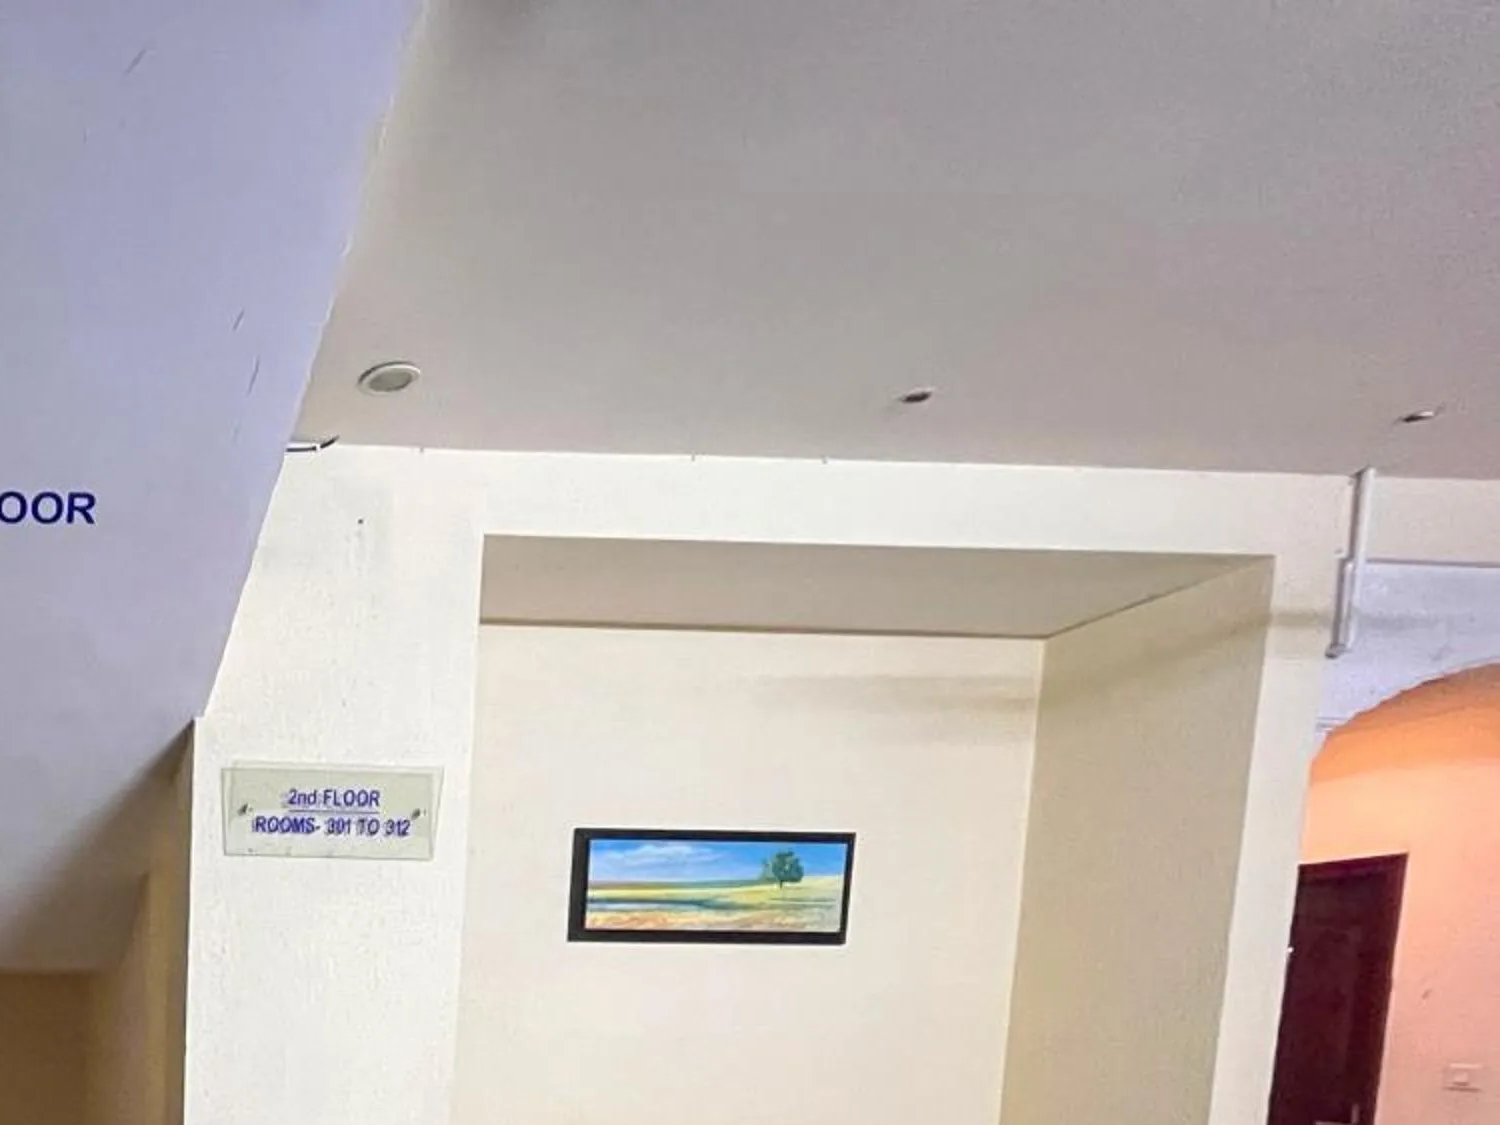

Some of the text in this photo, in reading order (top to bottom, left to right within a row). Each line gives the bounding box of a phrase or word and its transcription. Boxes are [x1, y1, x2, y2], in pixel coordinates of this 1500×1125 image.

[288, 788, 380, 808] 2nd FLOOR
[254, 816, 412, 838] ROOMS- 301 TO 312
